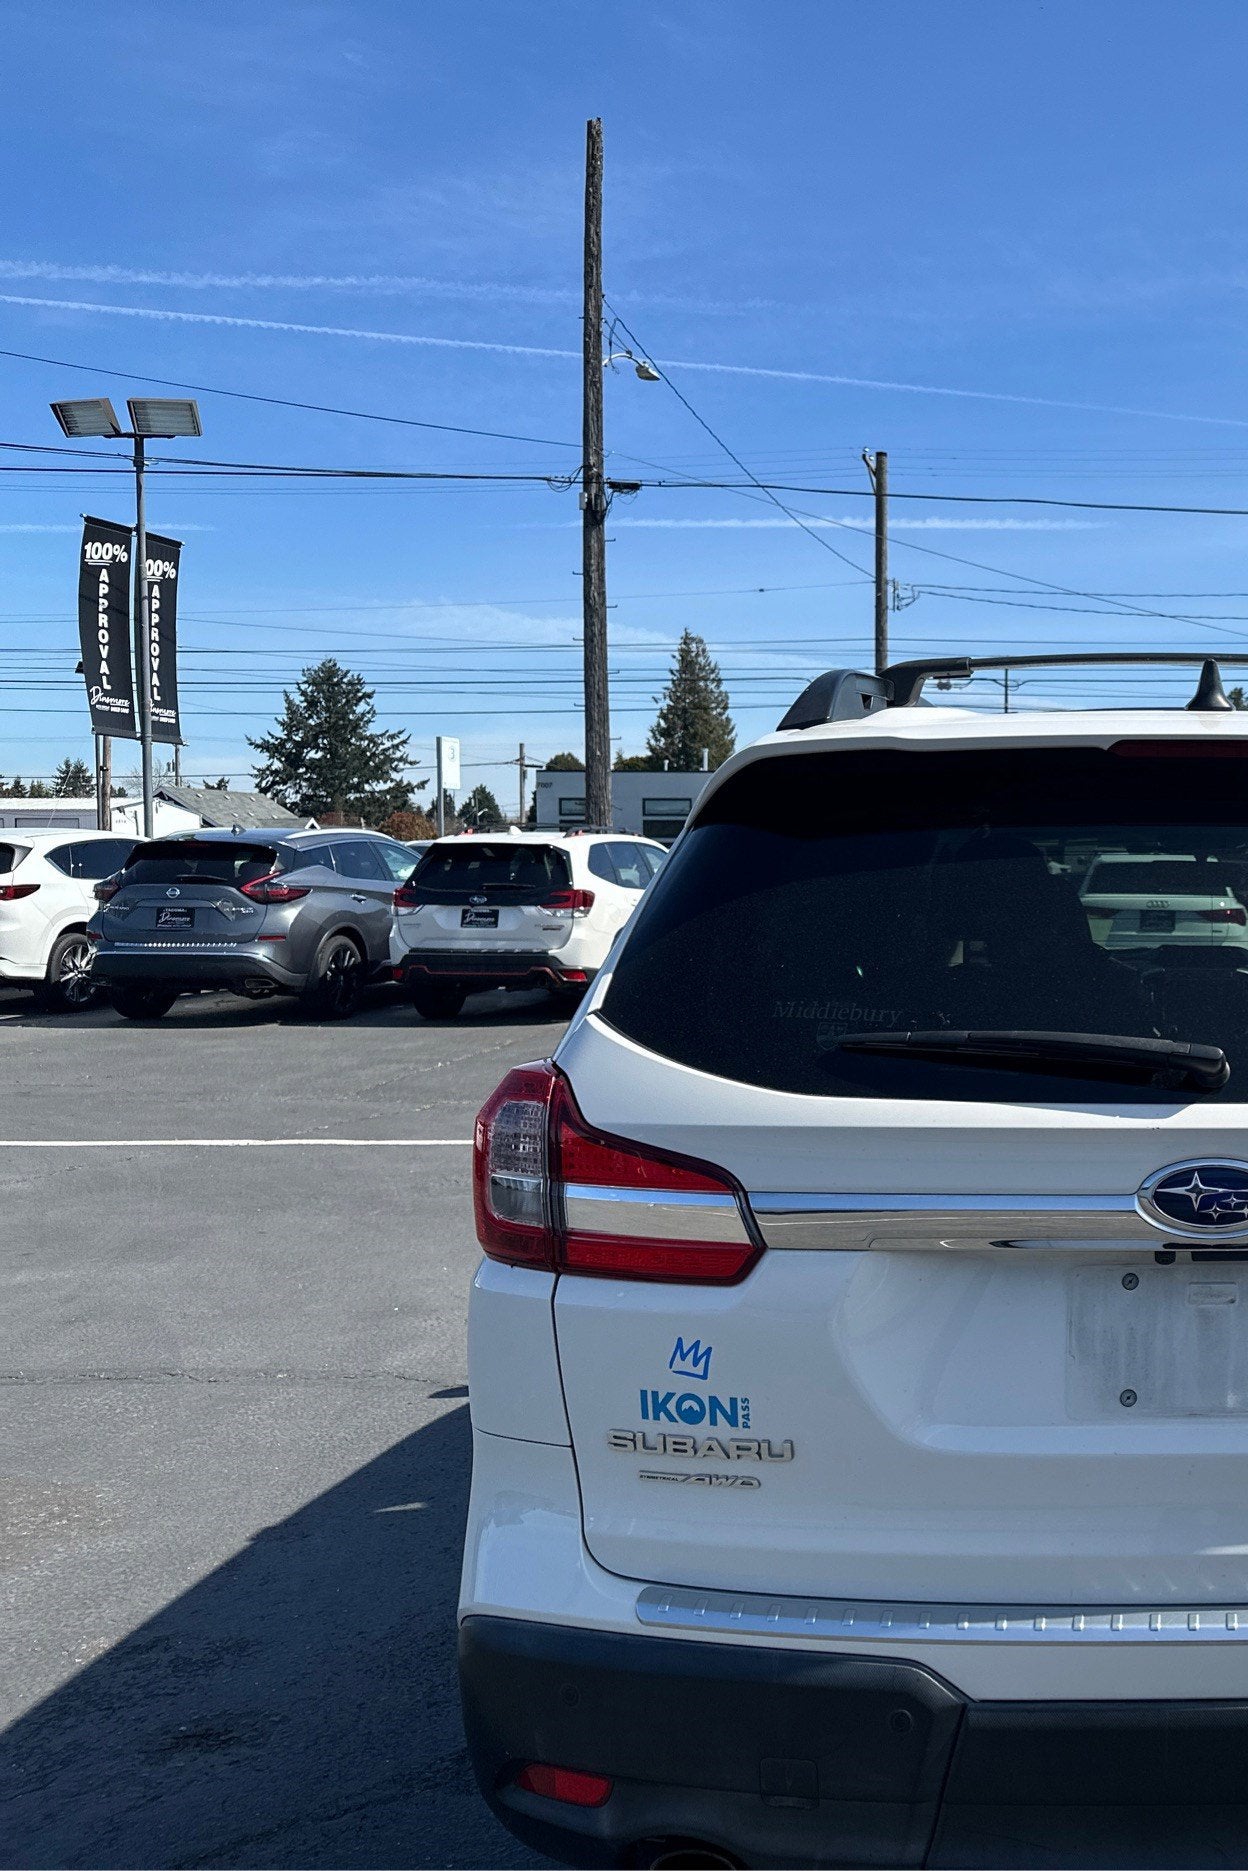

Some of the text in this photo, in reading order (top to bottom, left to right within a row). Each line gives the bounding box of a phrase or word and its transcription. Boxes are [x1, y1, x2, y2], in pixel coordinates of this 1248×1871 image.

[84, 541, 128, 563] 100%
[146, 559, 176, 579] 00%
[98, 568, 112, 690] APPROVAL
[150, 585, 161, 701] APPROVAL
[772, 1000, 903, 1028] Middlebury
[640, 1389, 751, 1429] IKON PASS
[607, 1428, 795, 1462] SUBARU
[683, 1473, 761, 1489] AWD
